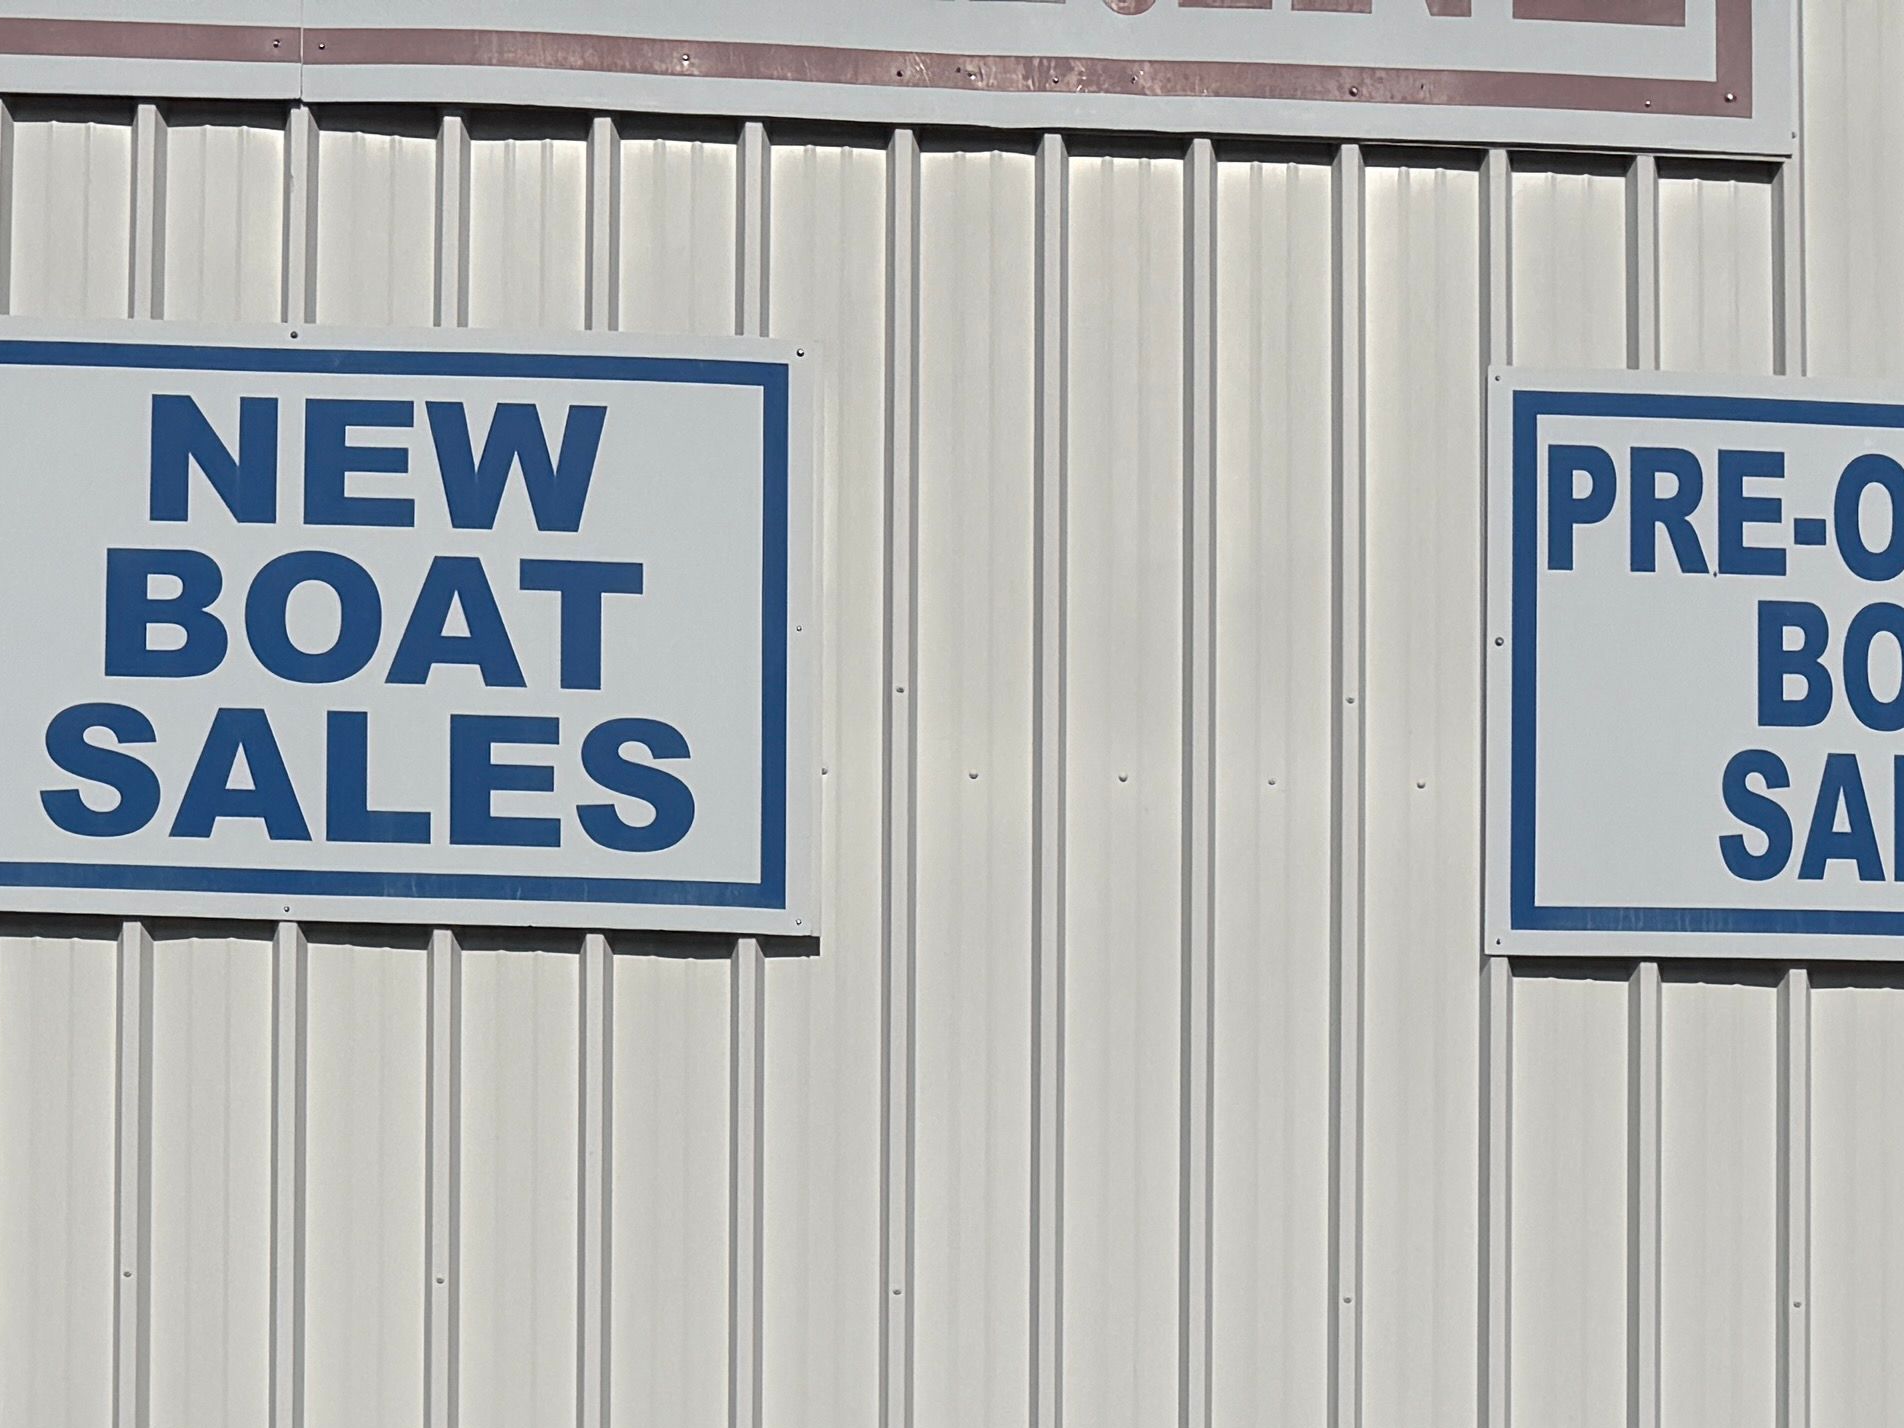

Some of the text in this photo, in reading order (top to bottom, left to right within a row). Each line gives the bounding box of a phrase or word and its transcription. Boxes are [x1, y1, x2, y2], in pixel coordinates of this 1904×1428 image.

[149, 394, 608, 532] NEW
[104, 547, 644, 691] BOAT
[39, 702, 696, 853] SALES
